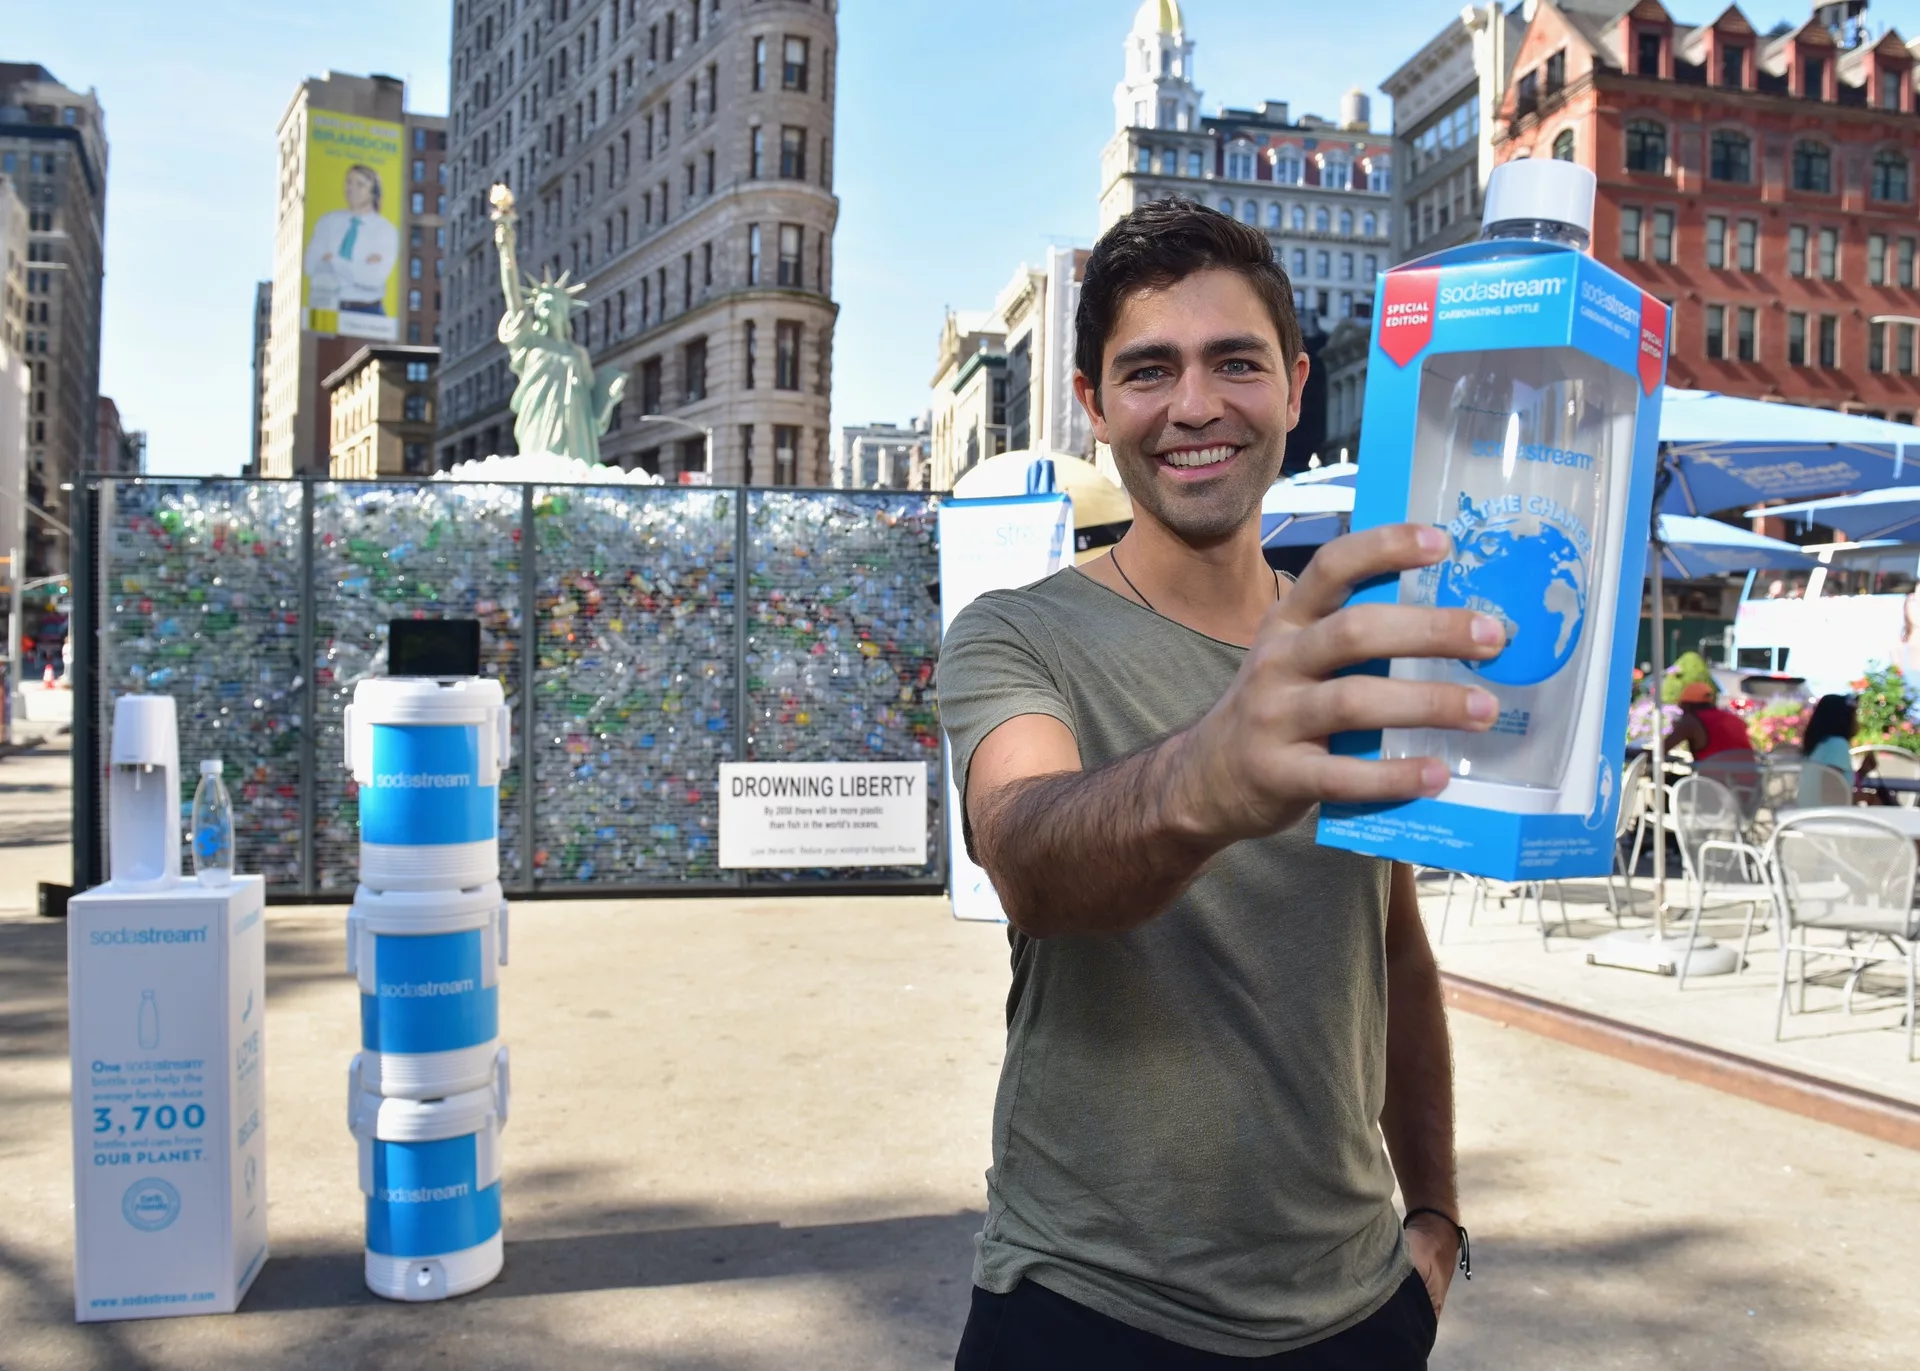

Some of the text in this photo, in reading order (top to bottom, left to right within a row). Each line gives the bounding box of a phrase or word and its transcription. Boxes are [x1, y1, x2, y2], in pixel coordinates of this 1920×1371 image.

[1440, 278, 1561, 304] sodastream
[1387, 302, 1429, 315] SPECIAL
[1438, 303, 1540, 320] CARBONATING BOTTLE
[1581, 280, 1640, 328] sodastream
[1385, 315, 1428, 328] EDITION
[1448, 509, 1475, 536] BE
[1479, 494, 1522, 520] THE
[1527, 495, 1593, 555] CHANGE
[376, 773, 470, 788] sodastream
[732, 776, 915, 797] DROWNING LIBERTY
[764, 806, 774, 816] By
[795, 806, 813, 815] there
[815, 806, 827, 815] will
[829, 806, 838, 815] be
[840, 807, 858, 815] more
[860, 806, 883, 816] plastic
[769, 820, 785, 829] than
[787, 820, 801, 829] fish
[812, 820, 823, 829] the
[825, 820, 851, 829] world's
[90, 924, 208, 946] sodastream
[380, 979, 474, 998] sodastream
[92, 1060, 121, 1073] One
[154, 1074, 180, 1086] help
[93, 1104, 206, 1137] 3,700
[93, 1148, 208, 1166] OUR PLANET.
[380, 1183, 468, 1203] sodastream
